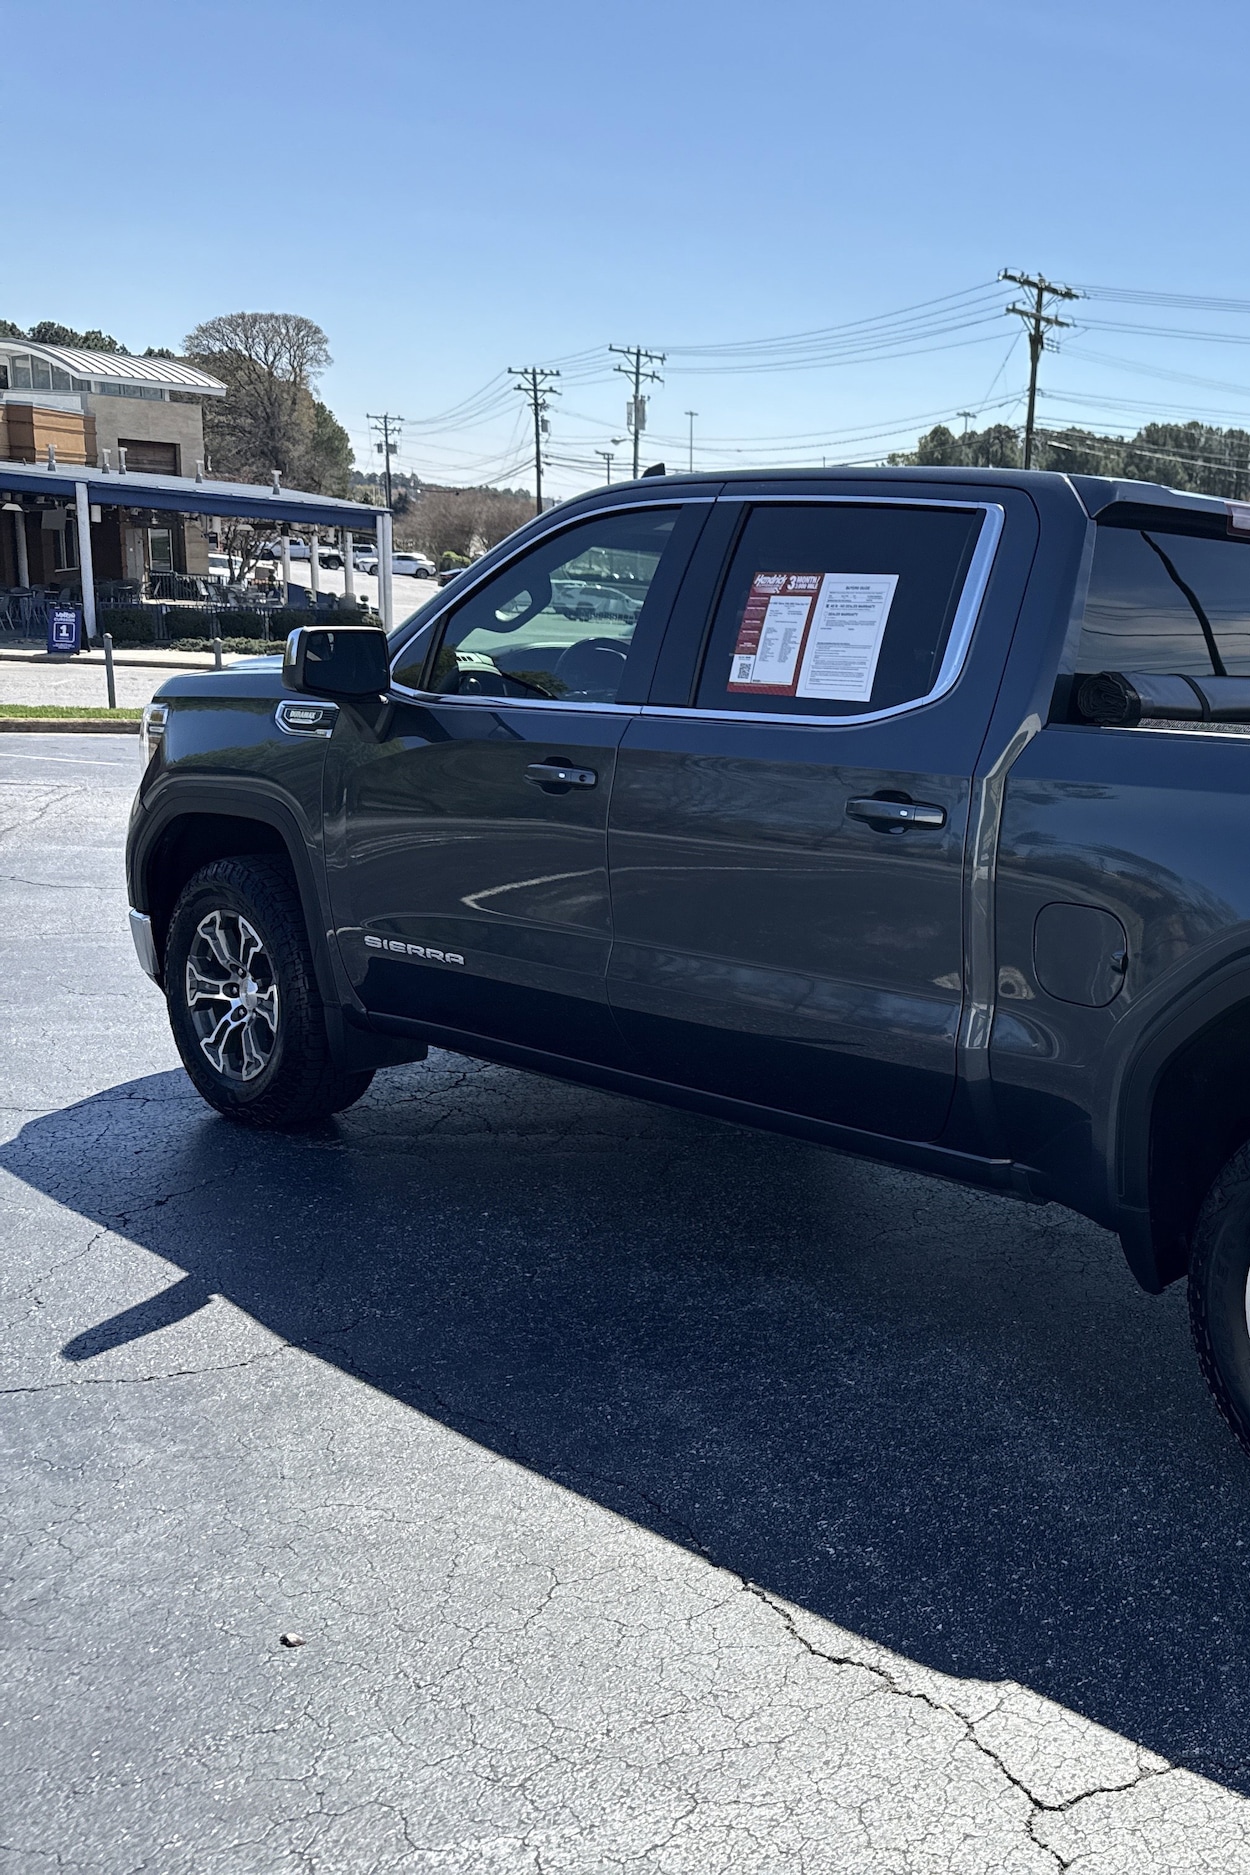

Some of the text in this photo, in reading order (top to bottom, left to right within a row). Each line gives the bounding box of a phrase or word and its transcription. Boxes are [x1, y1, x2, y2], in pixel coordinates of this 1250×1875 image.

[754, 574, 788, 591] Hendrick
[787, 575, 797, 590] 3
[60, 625, 70, 637] 1
[289, 710, 317, 719] DURAMAX
[364, 935, 465, 965] SIERRA
